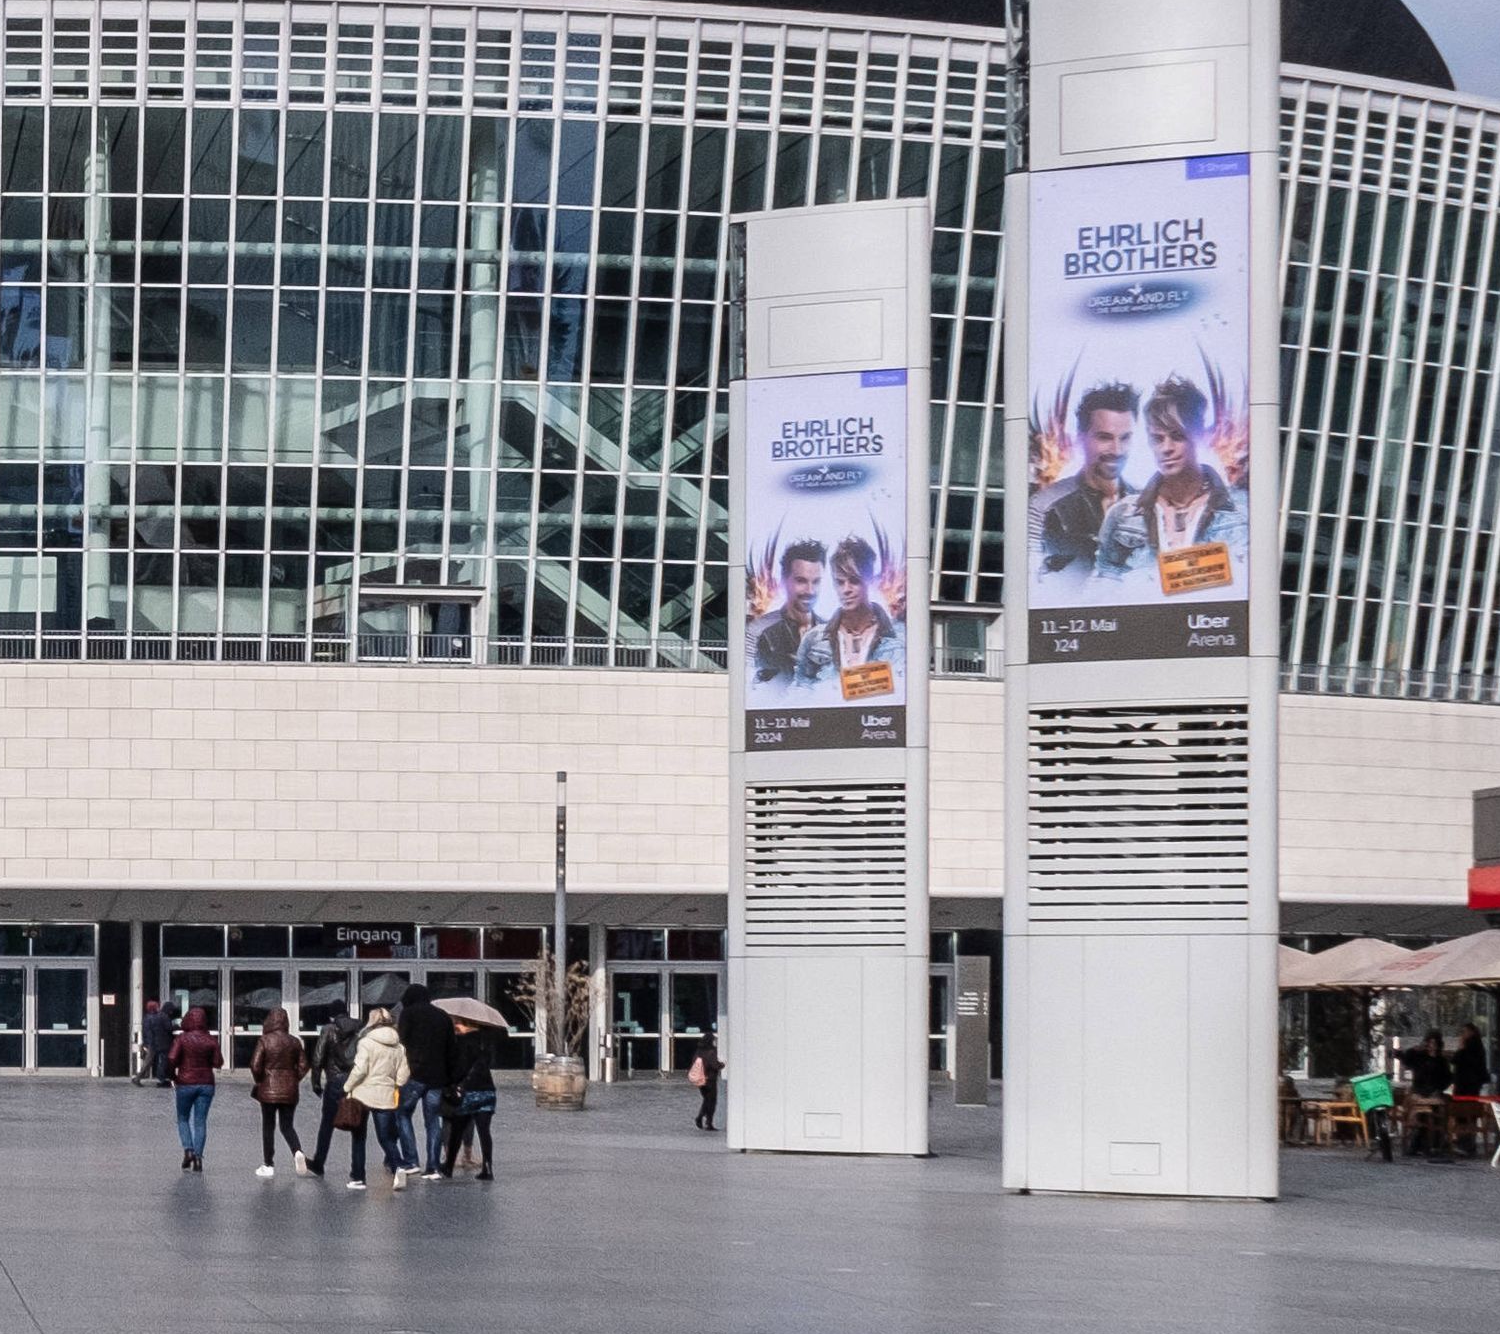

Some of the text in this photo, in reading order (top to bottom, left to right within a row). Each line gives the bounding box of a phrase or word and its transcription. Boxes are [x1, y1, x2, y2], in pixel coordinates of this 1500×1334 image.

[1078, 217, 1203, 250] EHRLICH
[1064, 242, 1217, 276] BROTHERS
[782, 417, 873, 439] EHRLICH
[772, 435, 883, 458] BROTHERS
[1090, 619, 1118, 632] Mai
[1188, 614, 1230, 629] Uber
[1188, 632, 1236, 647] Arena
[861, 715, 892, 727] Uber
[861, 729, 897, 740] Arena
[337, 927, 401, 944] Eingang
[617, 992, 638, 1027] 1
